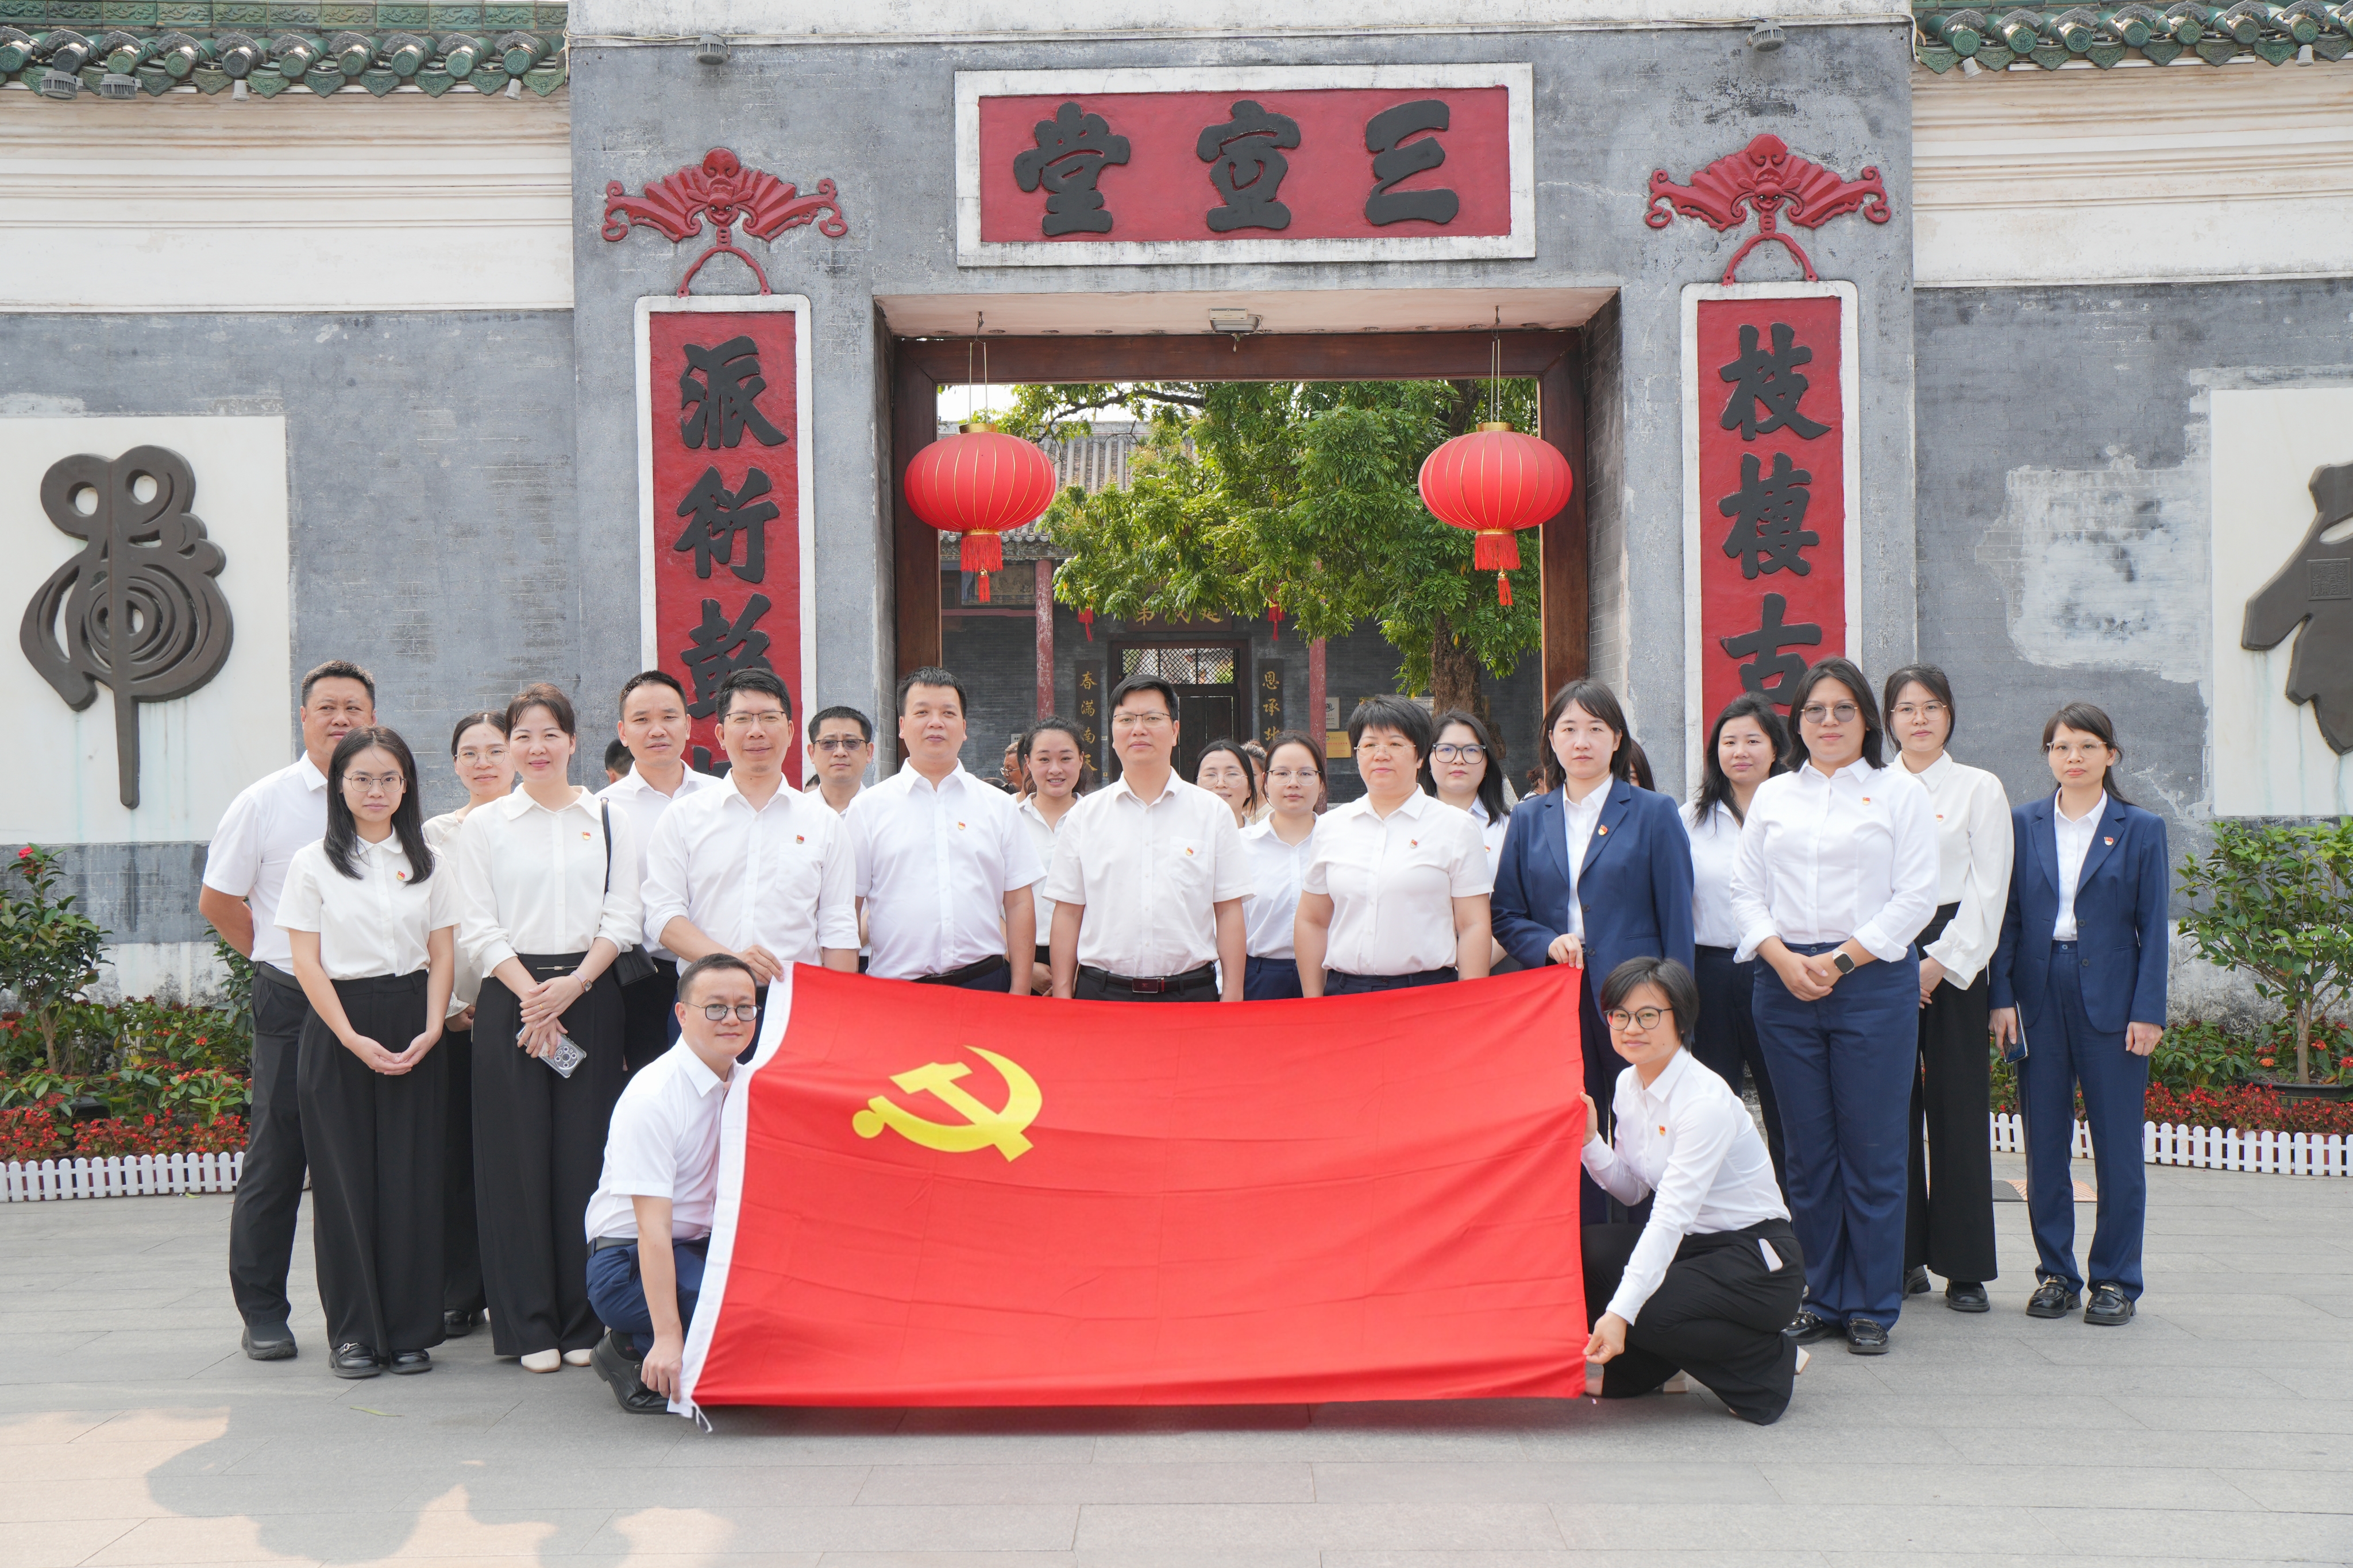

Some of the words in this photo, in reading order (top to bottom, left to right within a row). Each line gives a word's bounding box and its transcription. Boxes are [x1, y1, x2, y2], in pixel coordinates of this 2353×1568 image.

[674, 335, 788, 779] 派衍彭
[1718, 322, 1832, 741] 枝棲古
